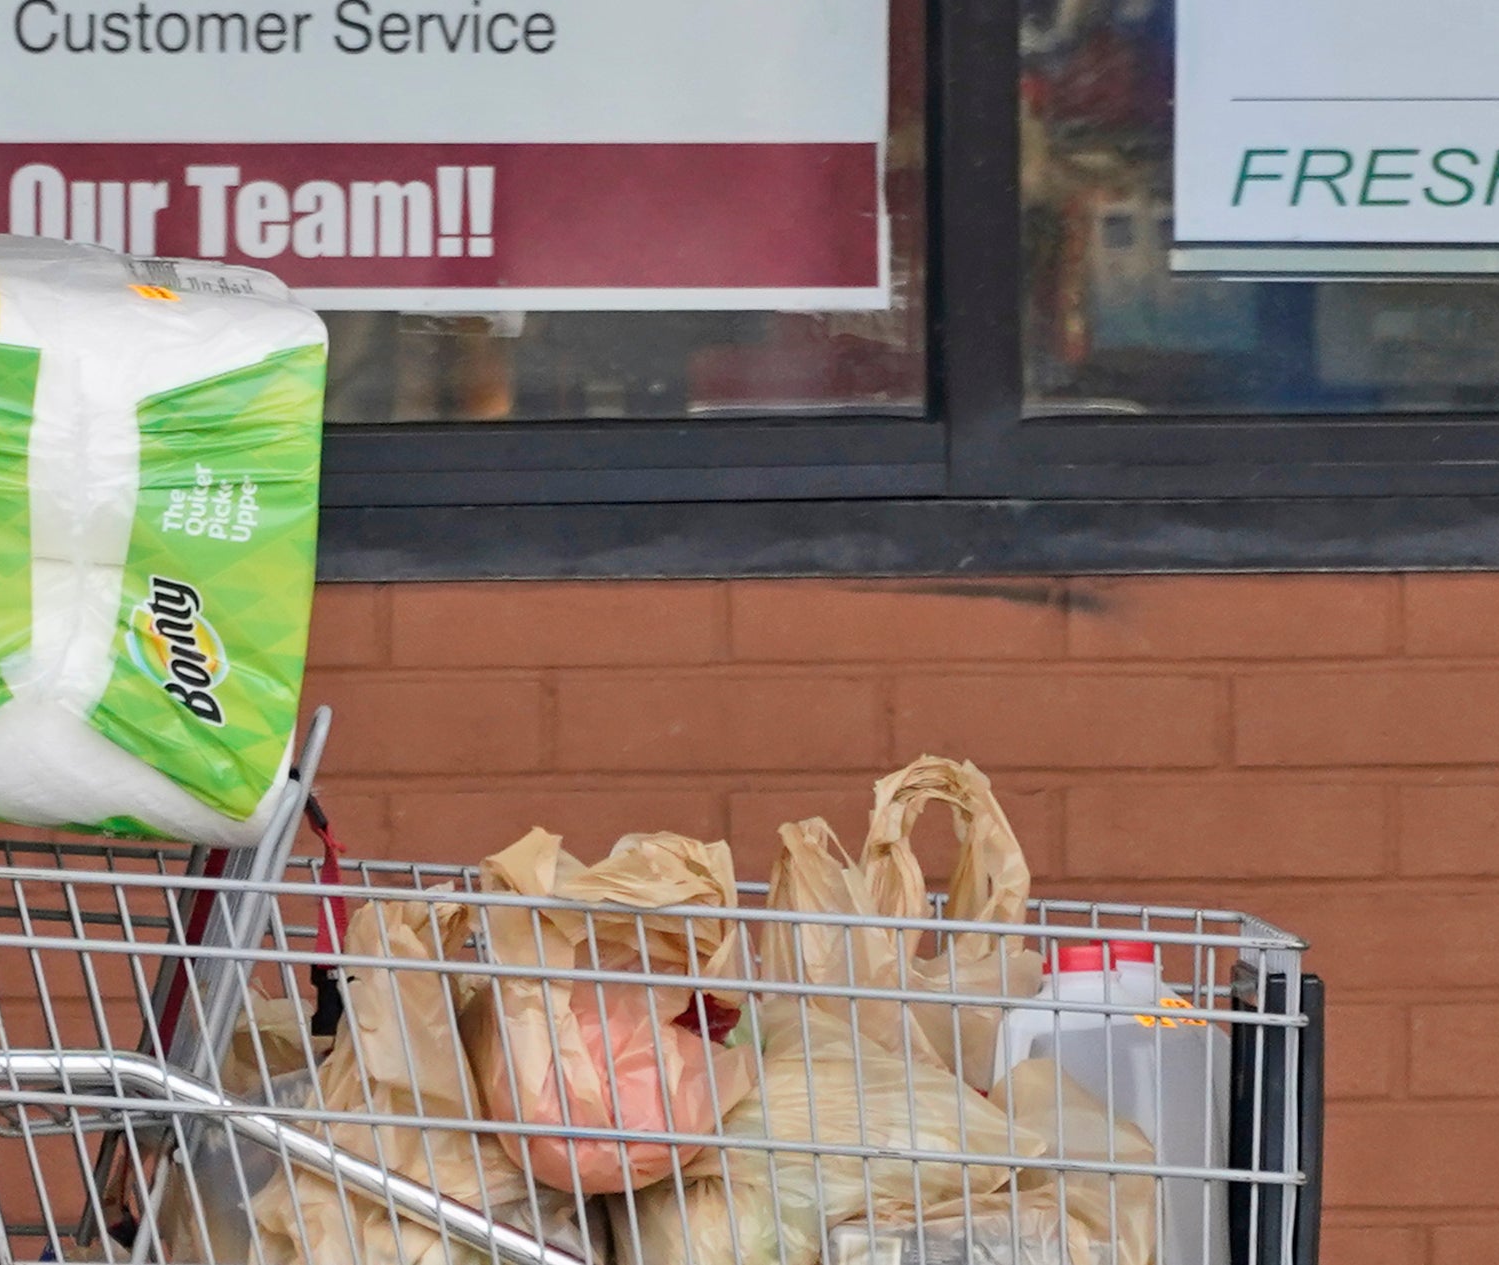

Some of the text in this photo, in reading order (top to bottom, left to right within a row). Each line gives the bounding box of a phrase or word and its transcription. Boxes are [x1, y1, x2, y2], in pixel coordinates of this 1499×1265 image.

[9, 163, 170, 257] Our
[185, 165, 496, 258] Team!!
[162, 488, 187, 533] The
[184, 462, 214, 537] Quicer
[230, 475, 259, 543] Uppe
